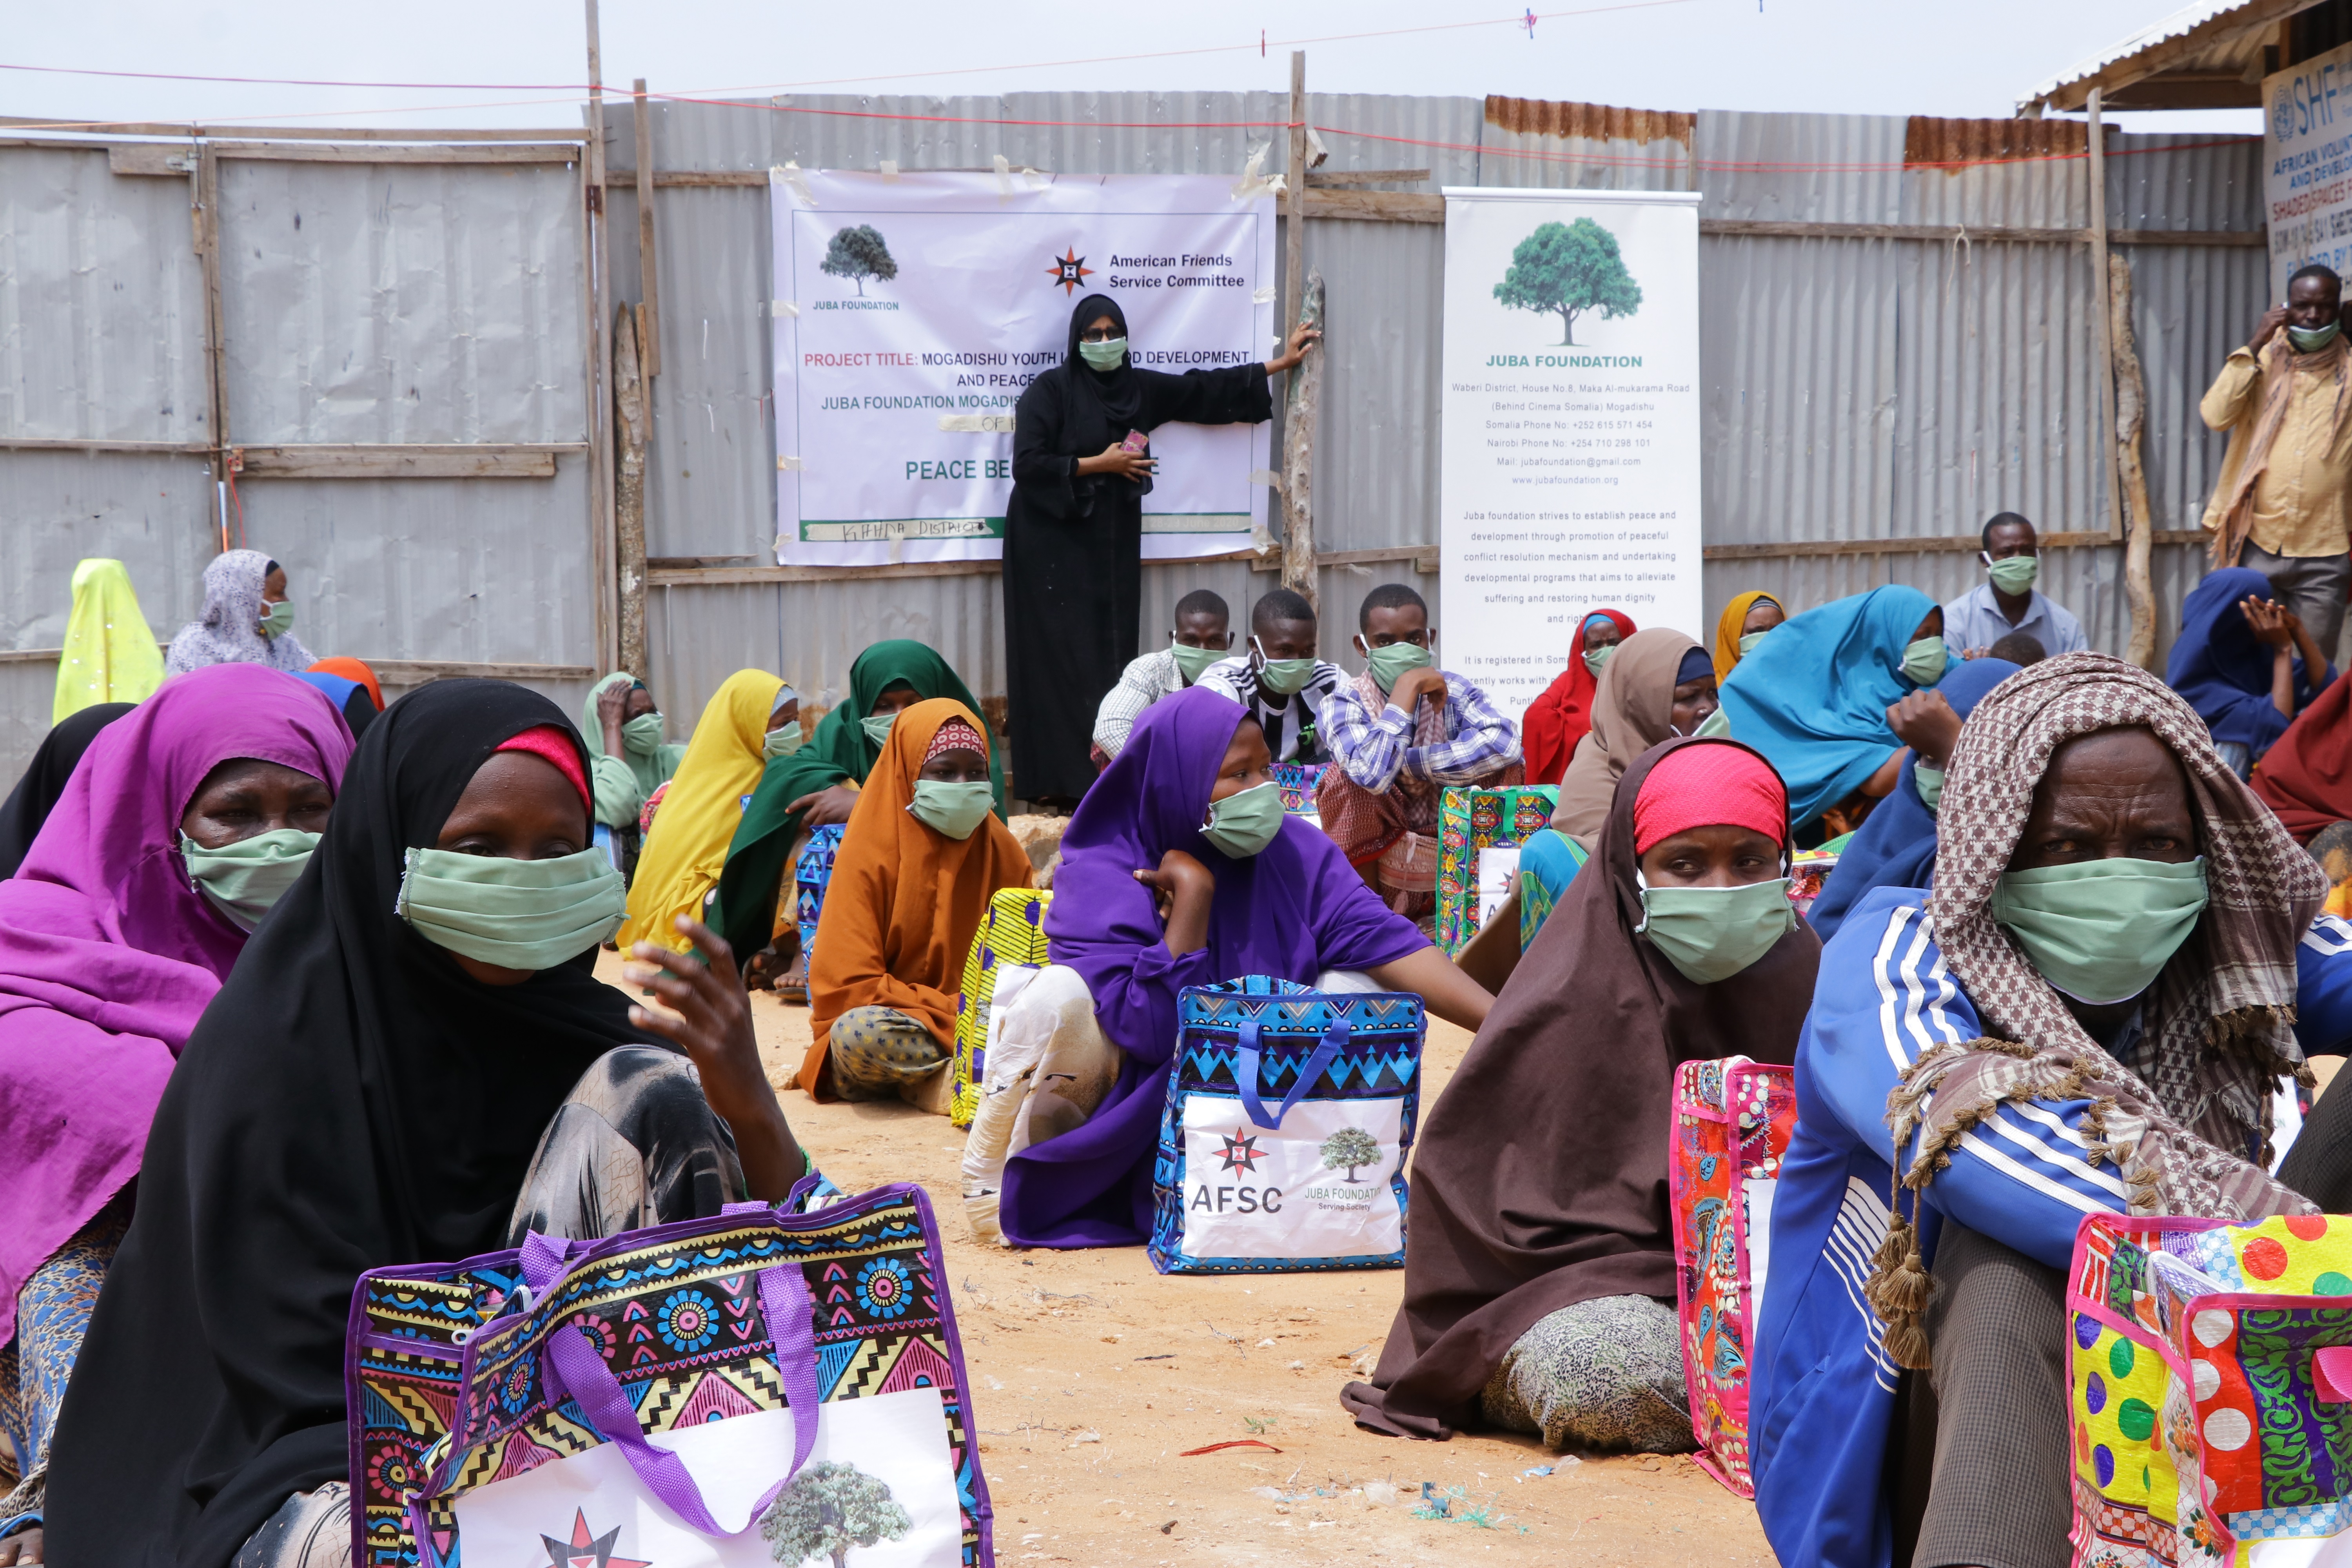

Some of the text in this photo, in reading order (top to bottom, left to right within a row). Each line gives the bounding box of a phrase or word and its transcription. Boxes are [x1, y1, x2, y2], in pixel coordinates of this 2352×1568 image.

[2294, 65, 2336, 135] SHF
[2274, 149, 2318, 175] AFRICAN
[2290, 171, 2311, 190] AND
[1110, 254, 1232, 267] American Friends
[1109, 275, 1244, 288] Service Committee
[813, 301, 899, 310] JUBA FOUNDATION
[805, 353, 871, 366] PROJECT
[876, 353, 918, 366] TITLE:
[922, 353, 1007, 365] MOGADISHU
[1012, 352, 1056, 365] YOUTH
[1147, 351, 1250, 363] DEVELOPMENT
[1486, 355, 1642, 367] JUBA FOUNDATION
[957, 374, 1035, 387] AND PEACE
[1452, 383, 1482, 391] Waberi
[1485, 383, 1518, 393] District,
[1522, 384, 1550, 392] House
[1553, 384, 1576, 394] No.8,
[1579, 384, 1602, 392] Maka
[1667, 384, 1690, 392] Road
[822, 397, 860, 409] JUBA
[864, 396, 954, 408] FOUNDATION
[1492, 401, 1654, 413] (Behind Cinema Somalia) Mogadishu
[982, 417, 1004, 431] OF
[1486, 420, 1652, 429] Somalia Phone No: +252 615 571 454
[1487, 438, 1650, 448] Nairobi Phone No: +254 710 298 101
[1497, 457, 1641, 468] Mail: jubafoundation@gmail.com
[906, 460, 976, 479] PEACE
[1512, 475, 1619, 486] www.jubafoundation.org
[1464, 511, 1485, 520] Juba
[1488, 511, 1535, 520] foundation
[1539, 512, 1569, 520] strives
[1584, 511, 1625, 519] establish
[1629, 512, 1656, 521] peace
[1660, 511, 1676, 519] and
[1471, 531, 1668, 543] development through promotion of peaceful
[1464, 552, 1676, 562] conflict resolution mechanism and undertaking
[1465, 573, 1530, 584] developmental
[1534, 575, 1575, 584] programs
[1579, 573, 1597, 581] that
[1600, 573, 1621, 581] aims
[1637, 573, 1675, 581] alleviate
[1485, 593, 1655, 605] suffering and restoring human dignity
[1547, 614, 1563, 622] and
[1465, 656, 1471, 664] It
[1474, 656, 1482, 664] is
[1485, 655, 1531, 666] registered
[1535, 655, 1543, 664] in
[1499, 676, 1525, 684] works
[1529, 676, 1547, 684] with
[1191, 1185, 1283, 1213] AFSC
[1305, 1188, 1330, 1199] JUBA
[1318, 1202, 1371, 1212] Serving Society
